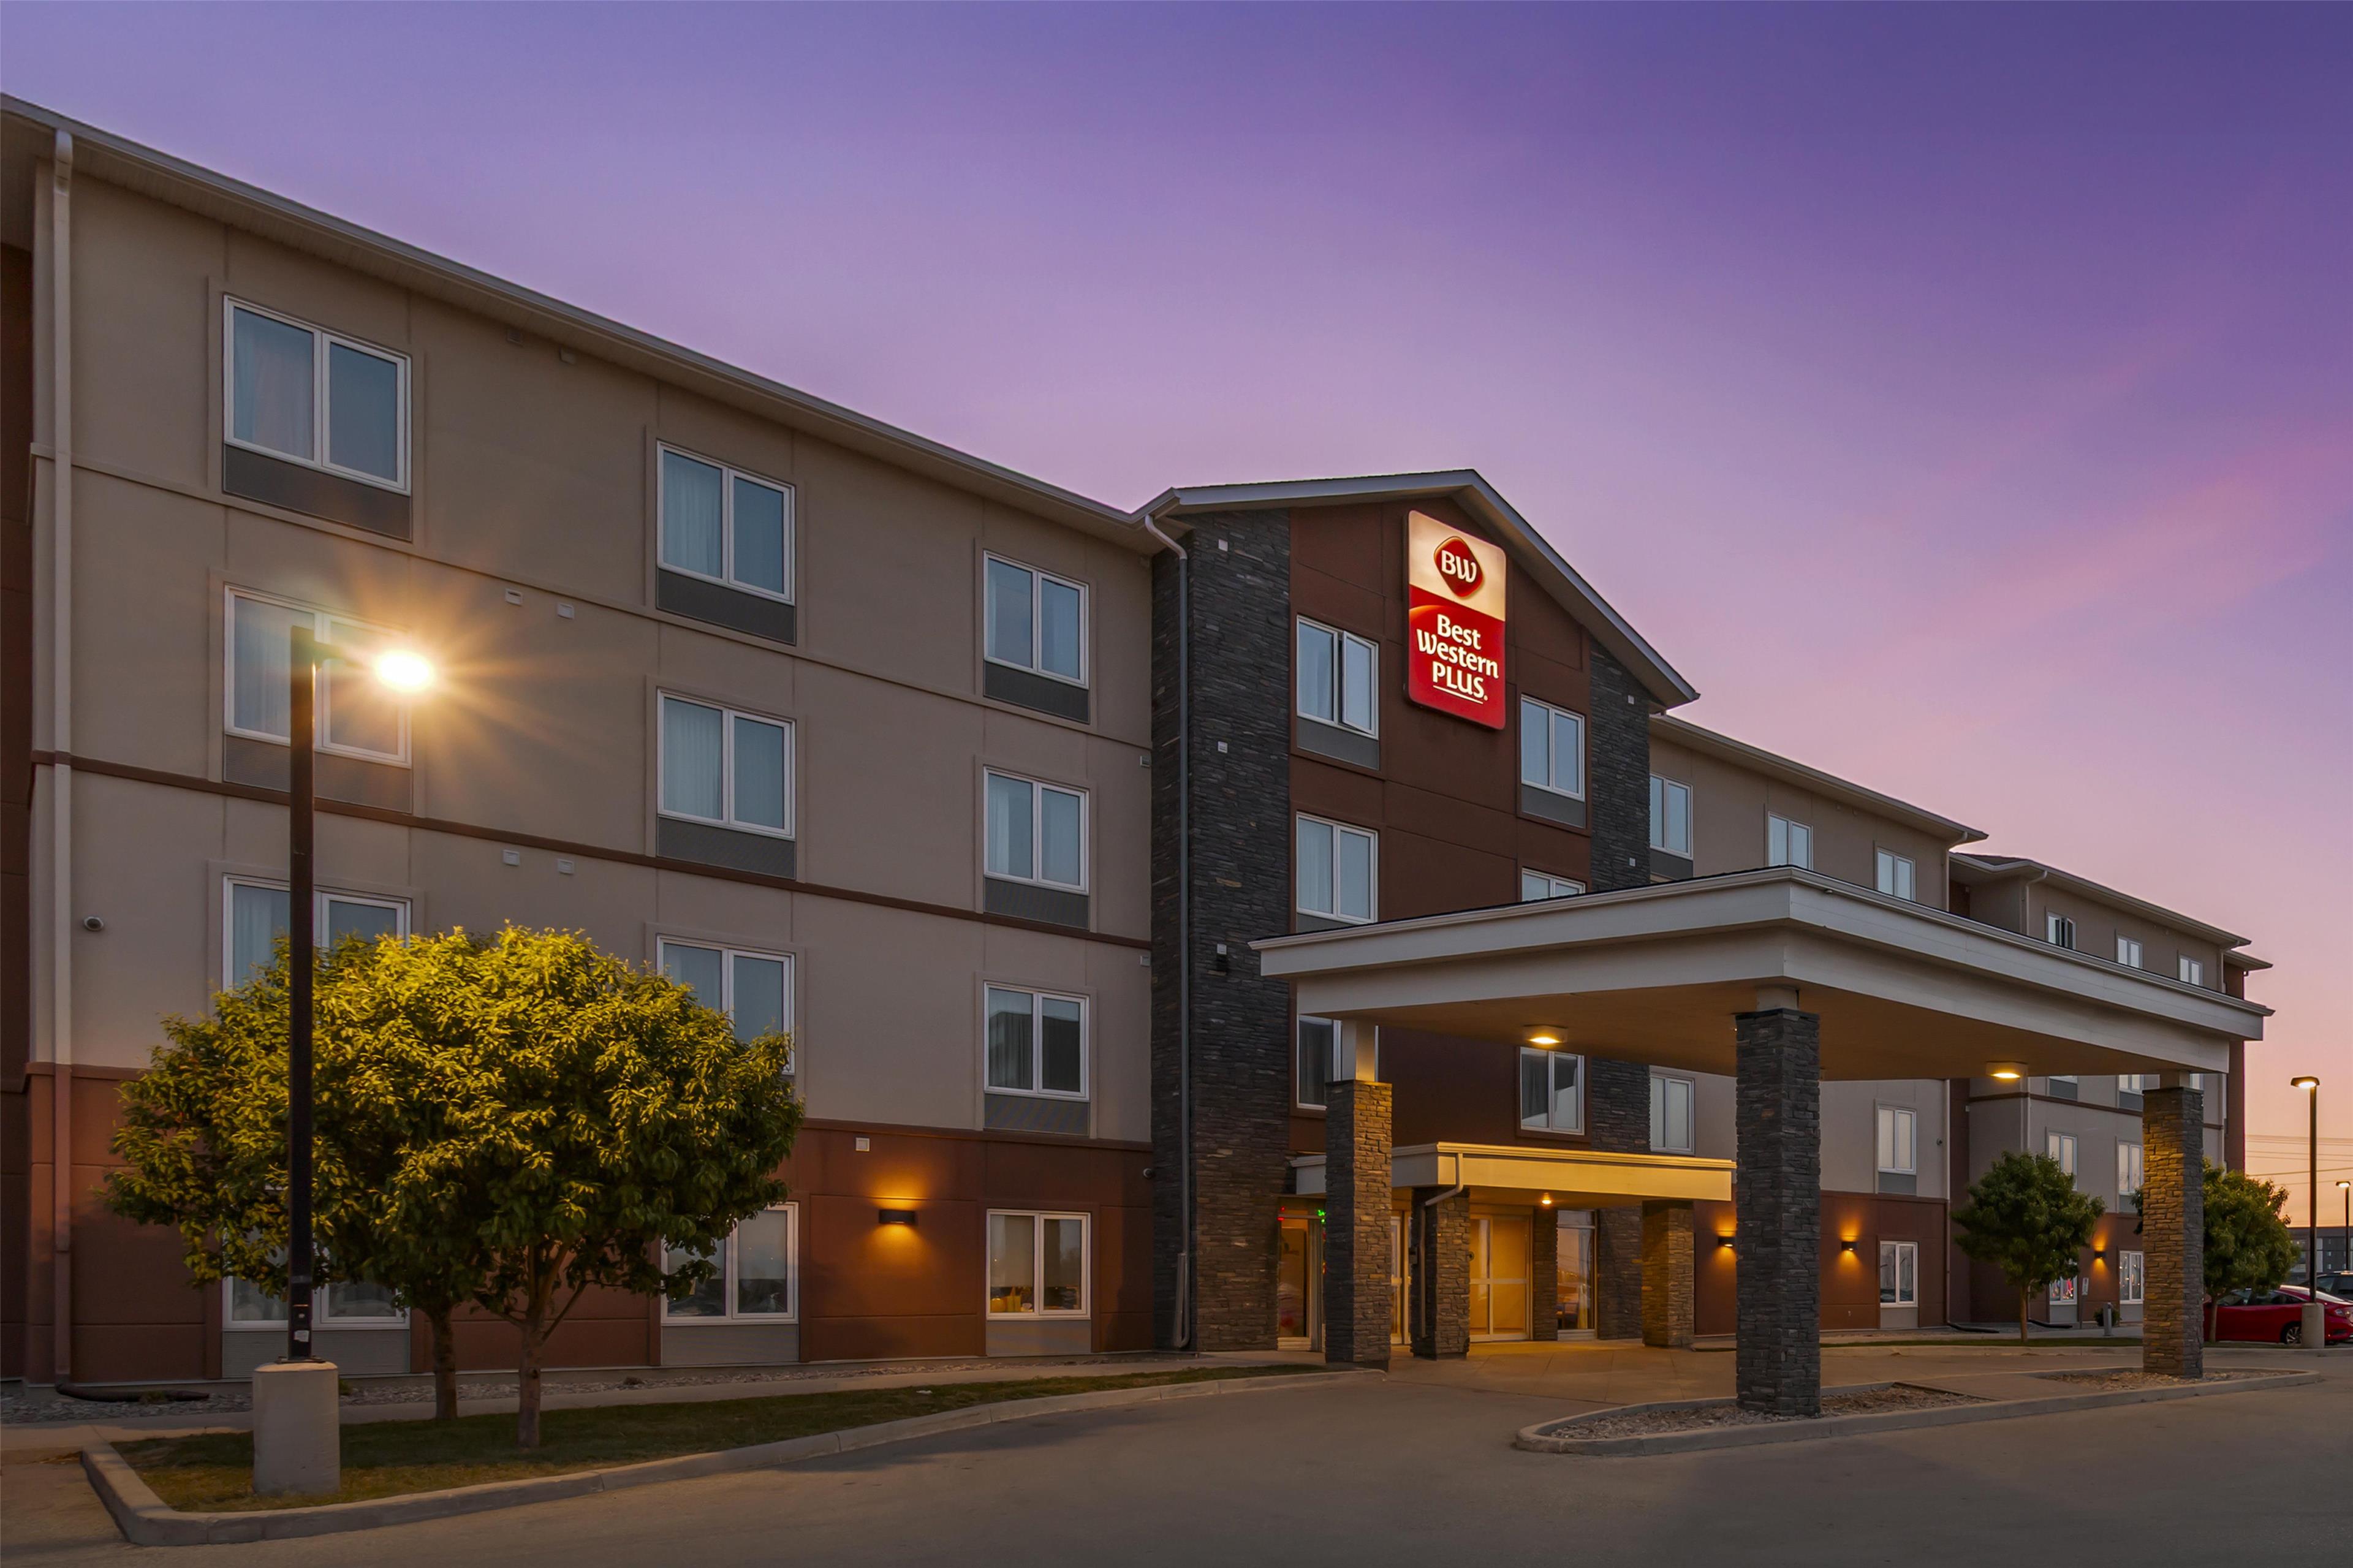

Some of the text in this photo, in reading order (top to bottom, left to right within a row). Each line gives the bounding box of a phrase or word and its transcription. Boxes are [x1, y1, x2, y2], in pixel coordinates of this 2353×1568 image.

[1441, 550, 1477, 583] BW
[1437, 614, 1481, 650] Best
[1417, 629, 1499, 679] Western
